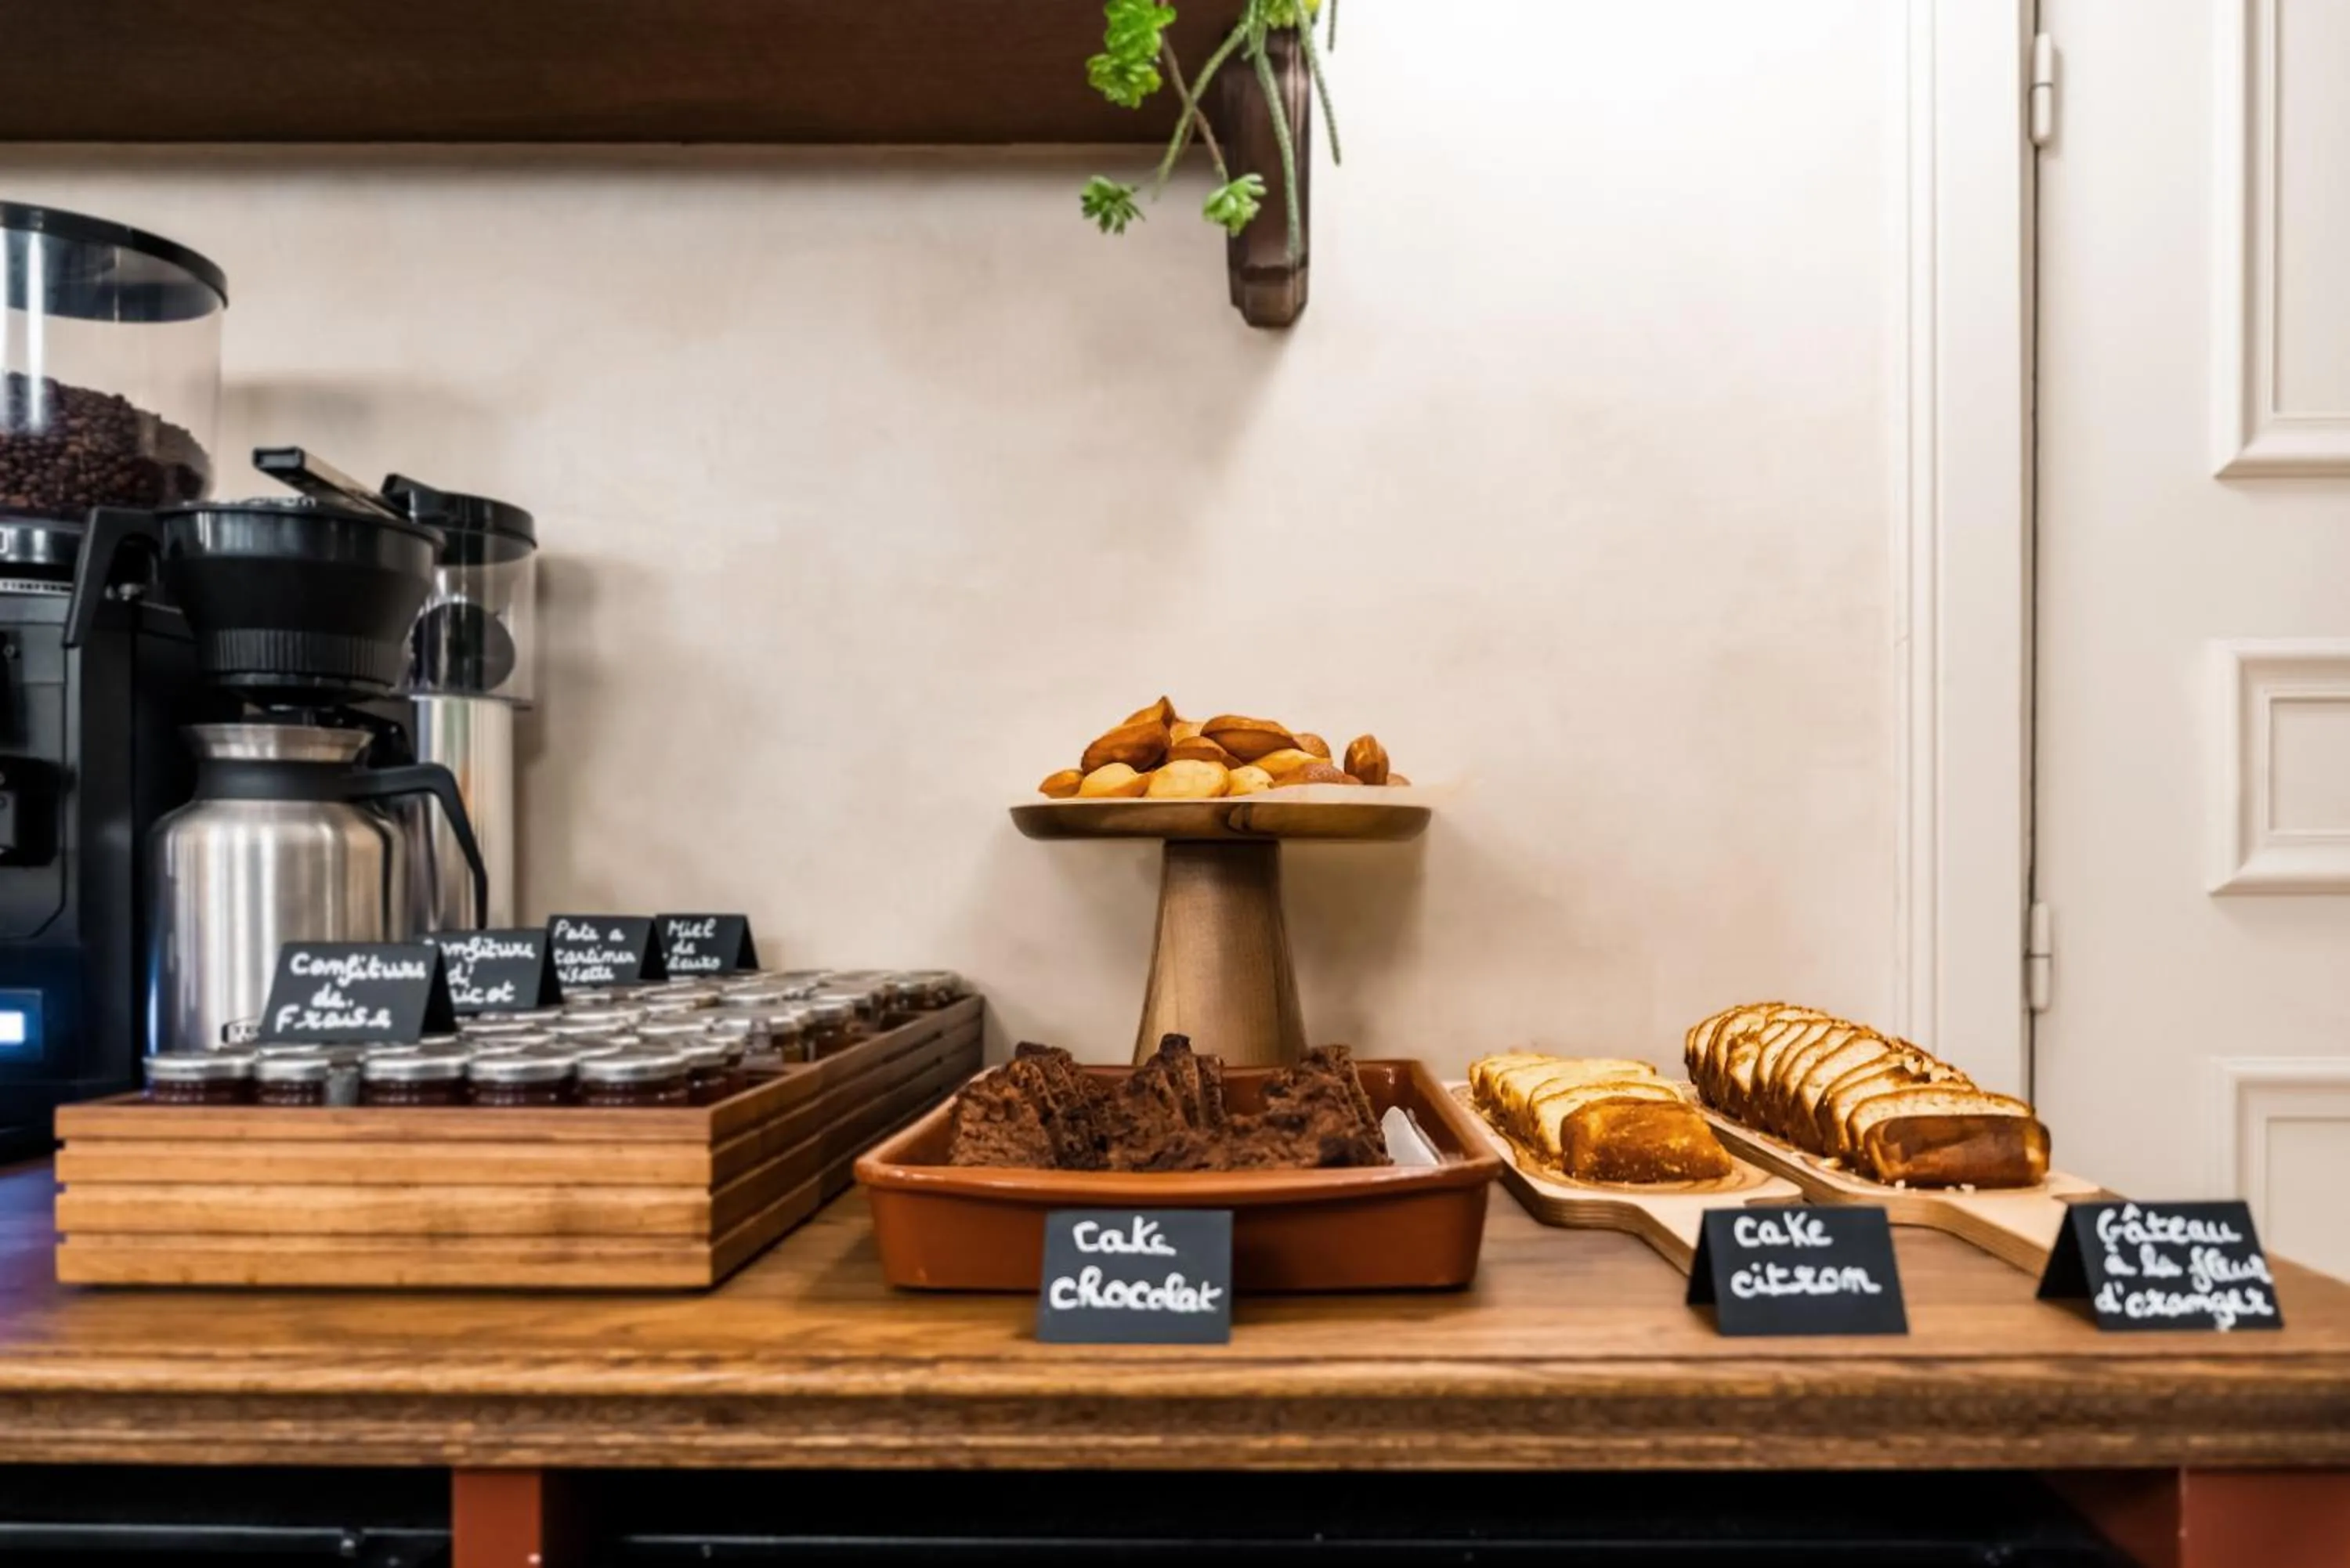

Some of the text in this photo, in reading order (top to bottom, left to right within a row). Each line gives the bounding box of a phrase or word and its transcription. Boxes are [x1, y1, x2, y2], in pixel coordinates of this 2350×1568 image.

[667, 918, 717, 938] Miel
[663, 953, 721, 970] leurs
[671, 939, 696, 955] de
[289, 952, 427, 988] Confiture
[275, 1005, 392, 1033] Fraise
[2096, 1203, 2243, 1245] Gâteau
[1730, 1262, 1882, 1299] citron
[2139, 1243, 2183, 1277] la
[2188, 1246, 2273, 1293] fleur
